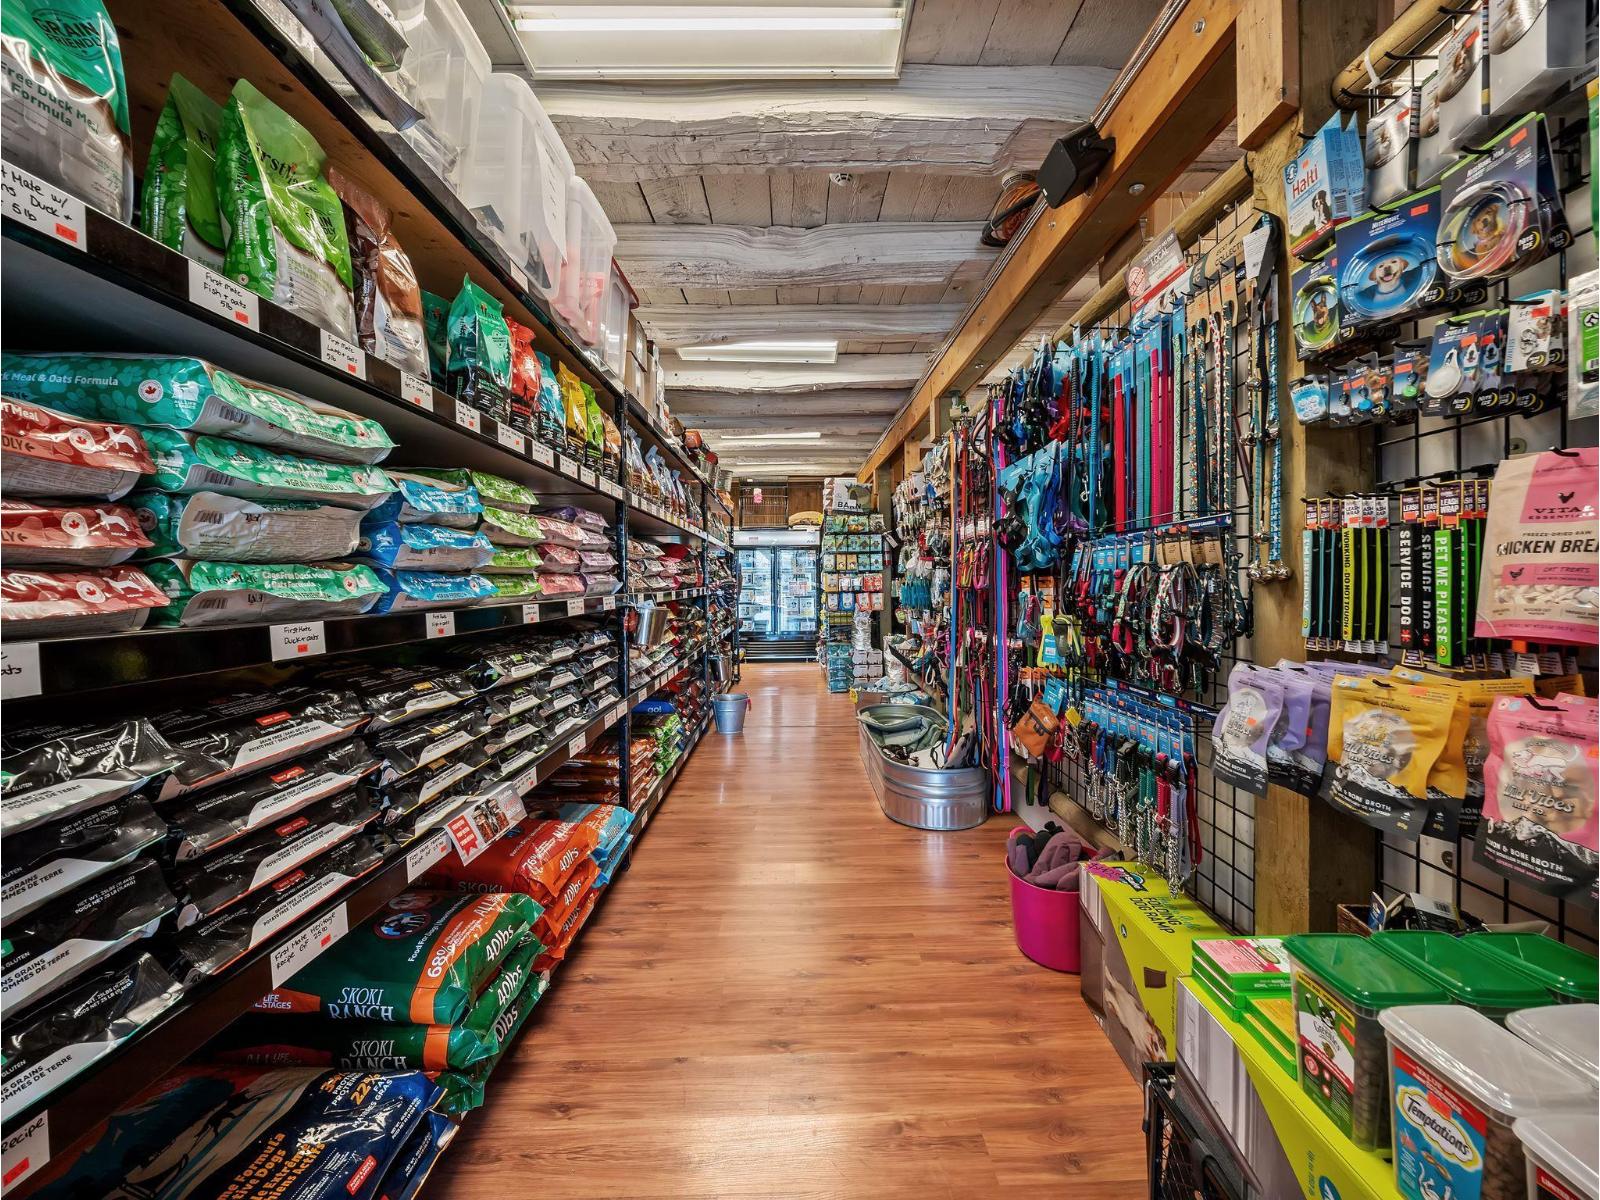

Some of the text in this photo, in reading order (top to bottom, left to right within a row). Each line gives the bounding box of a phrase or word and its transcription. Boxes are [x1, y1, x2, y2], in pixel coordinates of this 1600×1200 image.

[32, 16, 101, 37] GRAIN
[11, 82, 73, 128] Formula
[38, 85, 73, 114] Duck
[1292, 164, 1318, 200] Halti
[30, 194, 60, 217] Duck
[204, 281, 222, 298] Fish
[11, 373, 119, 387] Meal & Oats Formula
[12, 403, 39, 423] Meal
[1400, 530, 1412, 626] SERVICE DOG
[1435, 537, 1448, 643] PET ME PLEASE
[647, 705, 662, 714] go!
[1365, 799, 1391, 812] BROTH
[560, 847, 580, 872] 40lbs
[1531, 856, 1564, 873] BROTH
[9, 874, 39, 893] GRAINS
[27, 880, 38, 890] DE
[40, 868, 65, 883] TERRE
[563, 878, 582, 906] 40lbs
[1129, 897, 1175, 934] DOG RAMP
[1143, 896, 1182, 926] FOLDING
[310, 911, 337, 935] Heritage
[408, 942, 423, 962] Food
[485, 923, 515, 963] 40lbs
[6, 951, 31, 967] GLUTEN
[15, 957, 46, 979] GRAINS
[34, 966, 47, 975] DE
[47, 949, 70, 967] TERRE
[338, 987, 385, 1005] SKOKI
[497, 963, 523, 1007] 40lbs
[262, 1002, 292, 1010] STAGES
[263, 994, 280, 1003] LIFE
[328, 1003, 397, 1021] RANCH
[350, 1040, 396, 1058] SKOKI
[10, 1066, 43, 1088] GRAINS
[33, 1072, 45, 1081] DE
[46, 1055, 72, 1073] TERRE
[374, 1075, 388, 1092] FAT
[375, 1079, 393, 1101] GRAS
[1407, 1096, 1469, 1156] Temptations
[235, 1132, 286, 1181] Formula
[255, 1149, 287, 1178] Dogs
[292, 1143, 326, 1175] Actifs
